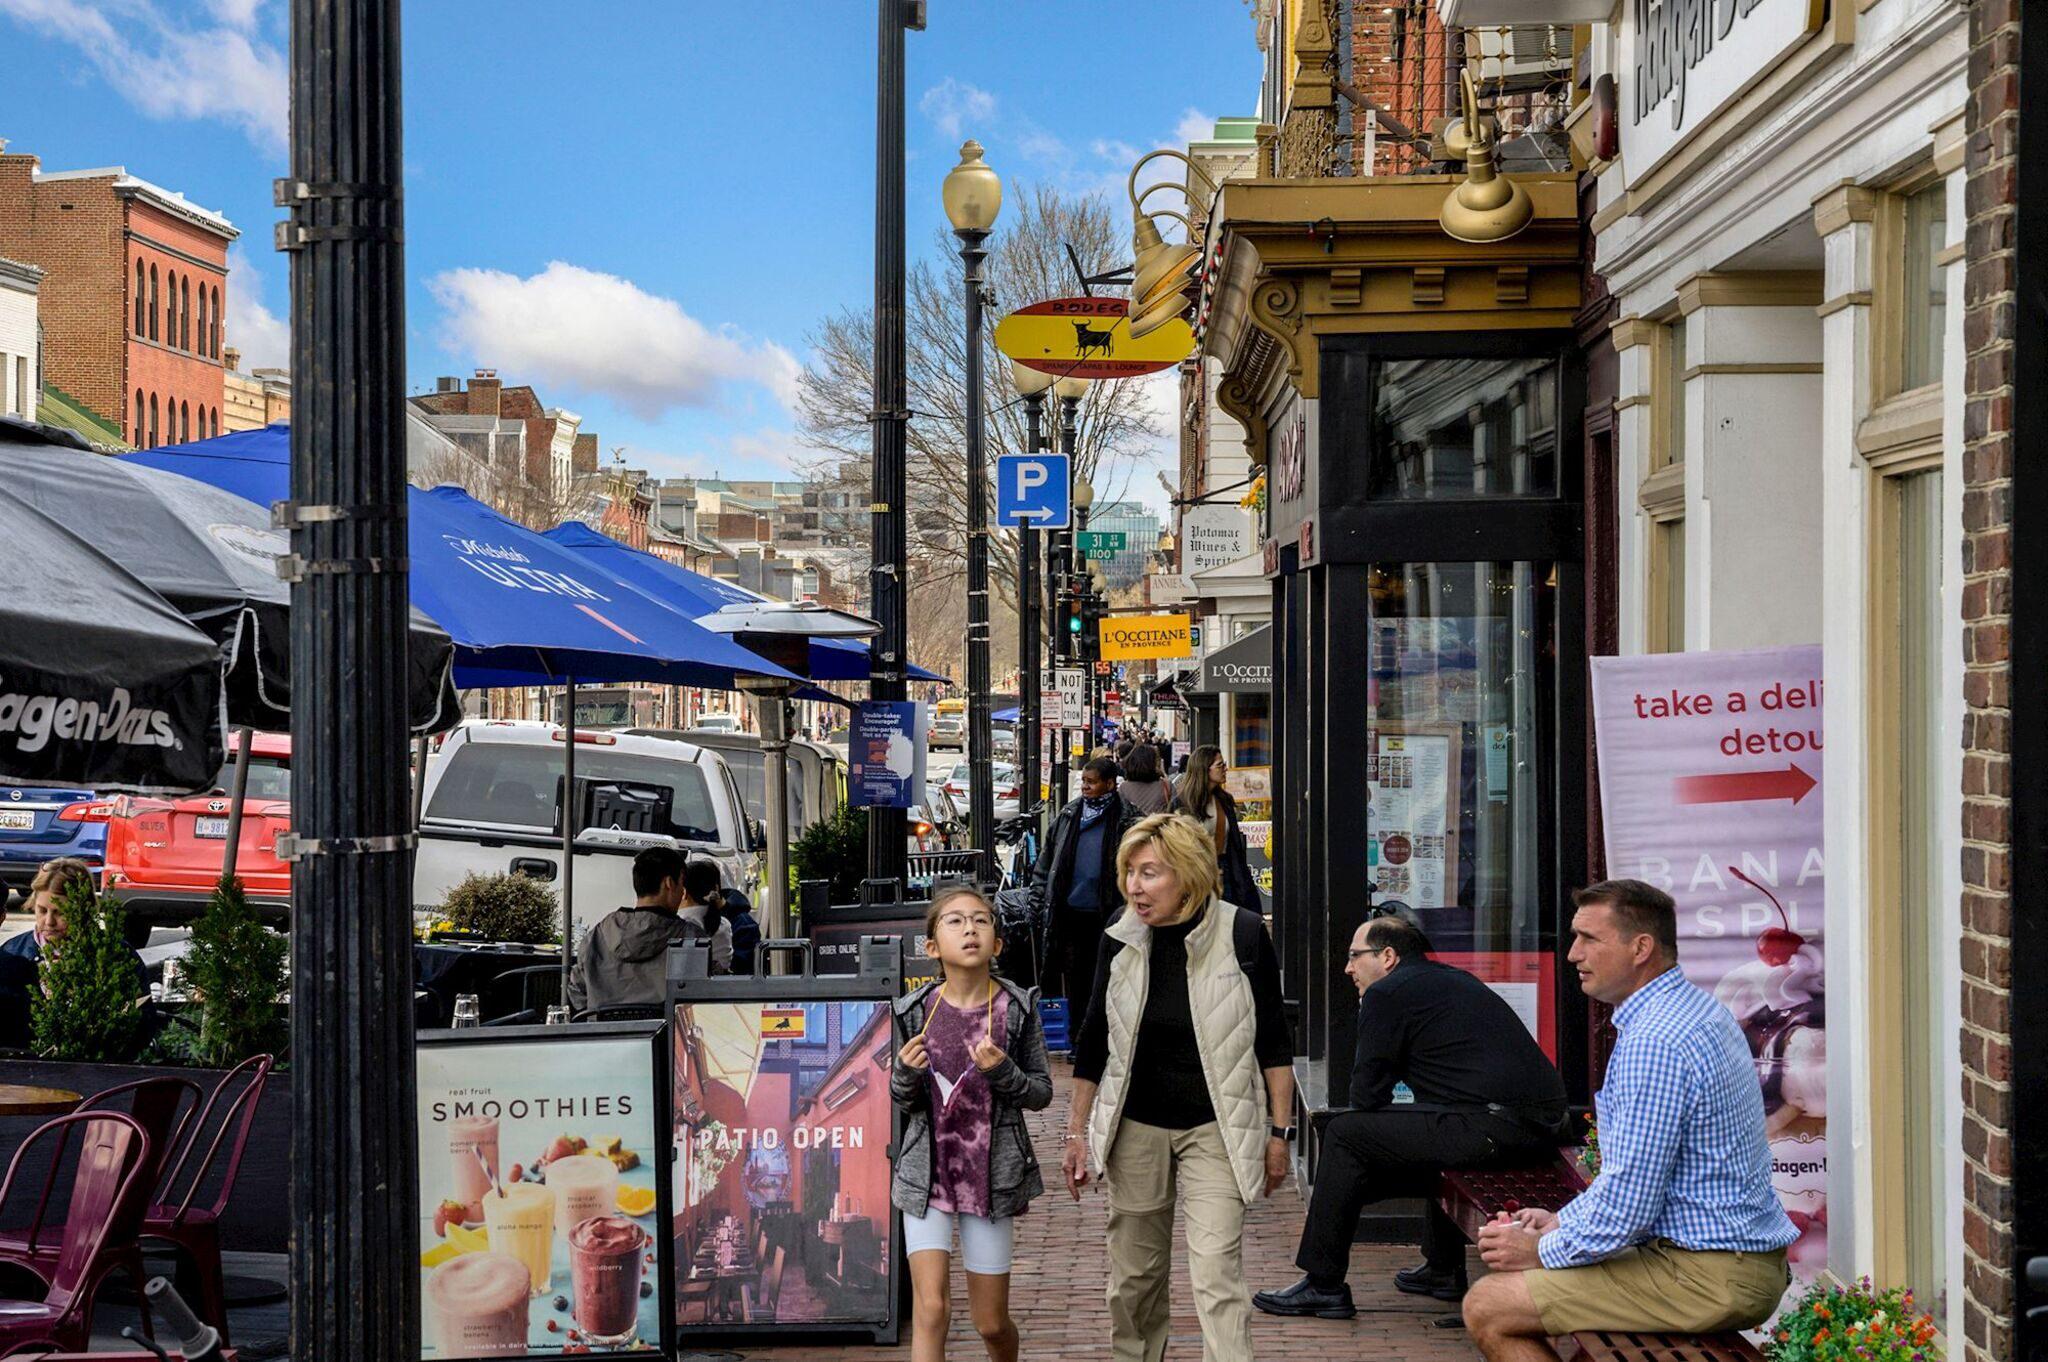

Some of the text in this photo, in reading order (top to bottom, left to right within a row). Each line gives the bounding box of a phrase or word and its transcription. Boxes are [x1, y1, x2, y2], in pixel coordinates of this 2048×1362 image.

[1052, 302, 1126, 313] BODEG
[1191, 525, 1240, 540] Potomac
[1092, 534, 1103, 548] 31
[1190, 540, 1227, 552] Wines
[1089, 549, 1111, 559] 1100
[457, 556, 612, 603] ULTRA
[1104, 629, 1187, 643] L'OCCITANE
[1132, 640, 1172, 648] PROVENCE
[1213, 664, 1272, 677] L'OCCIT
[1061, 675, 1080, 687] NOT
[1634, 689, 1713, 719] take
[1727, 691, 1746, 713] a
[1720, 728, 1824, 756] detou
[1639, 847, 1825, 893] BANA
[1695, 901, 1820, 939] SPL
[820, 944, 858, 955] ORDER ONLINE
[449, 1087, 491, 1096] real fruit
[432, 1096, 633, 1122] SMOOTHIES
[700, 1126, 864, 1150] PATIO OPEN
